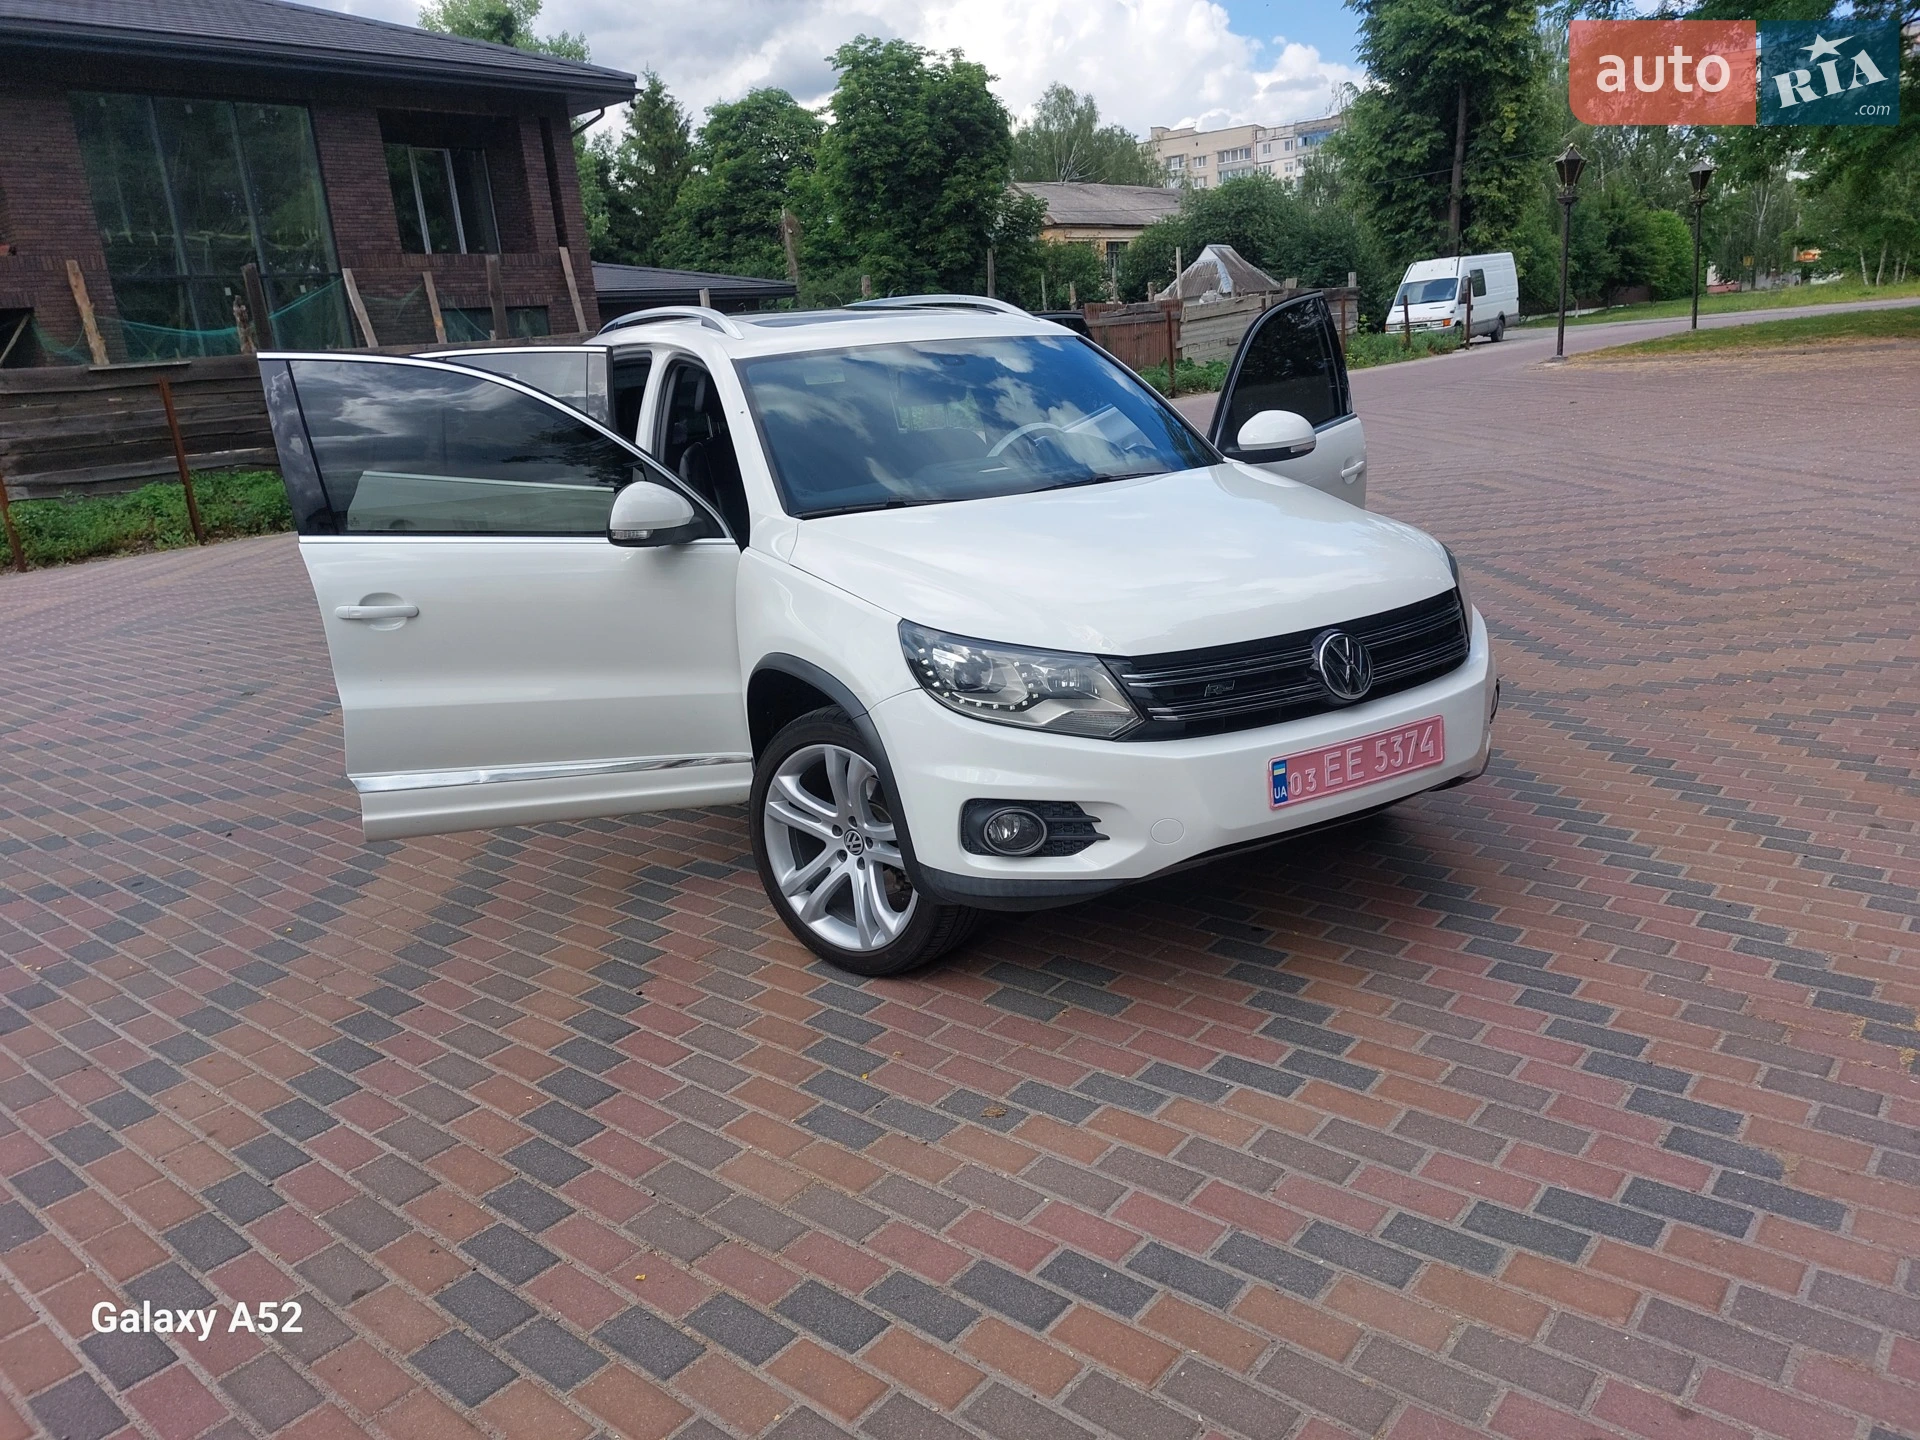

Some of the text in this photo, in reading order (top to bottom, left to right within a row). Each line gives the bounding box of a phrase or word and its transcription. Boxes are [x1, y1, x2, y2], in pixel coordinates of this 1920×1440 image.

[1290, 725, 1434, 796] 03 EE 5374
[1273, 786, 1287, 799] UA
